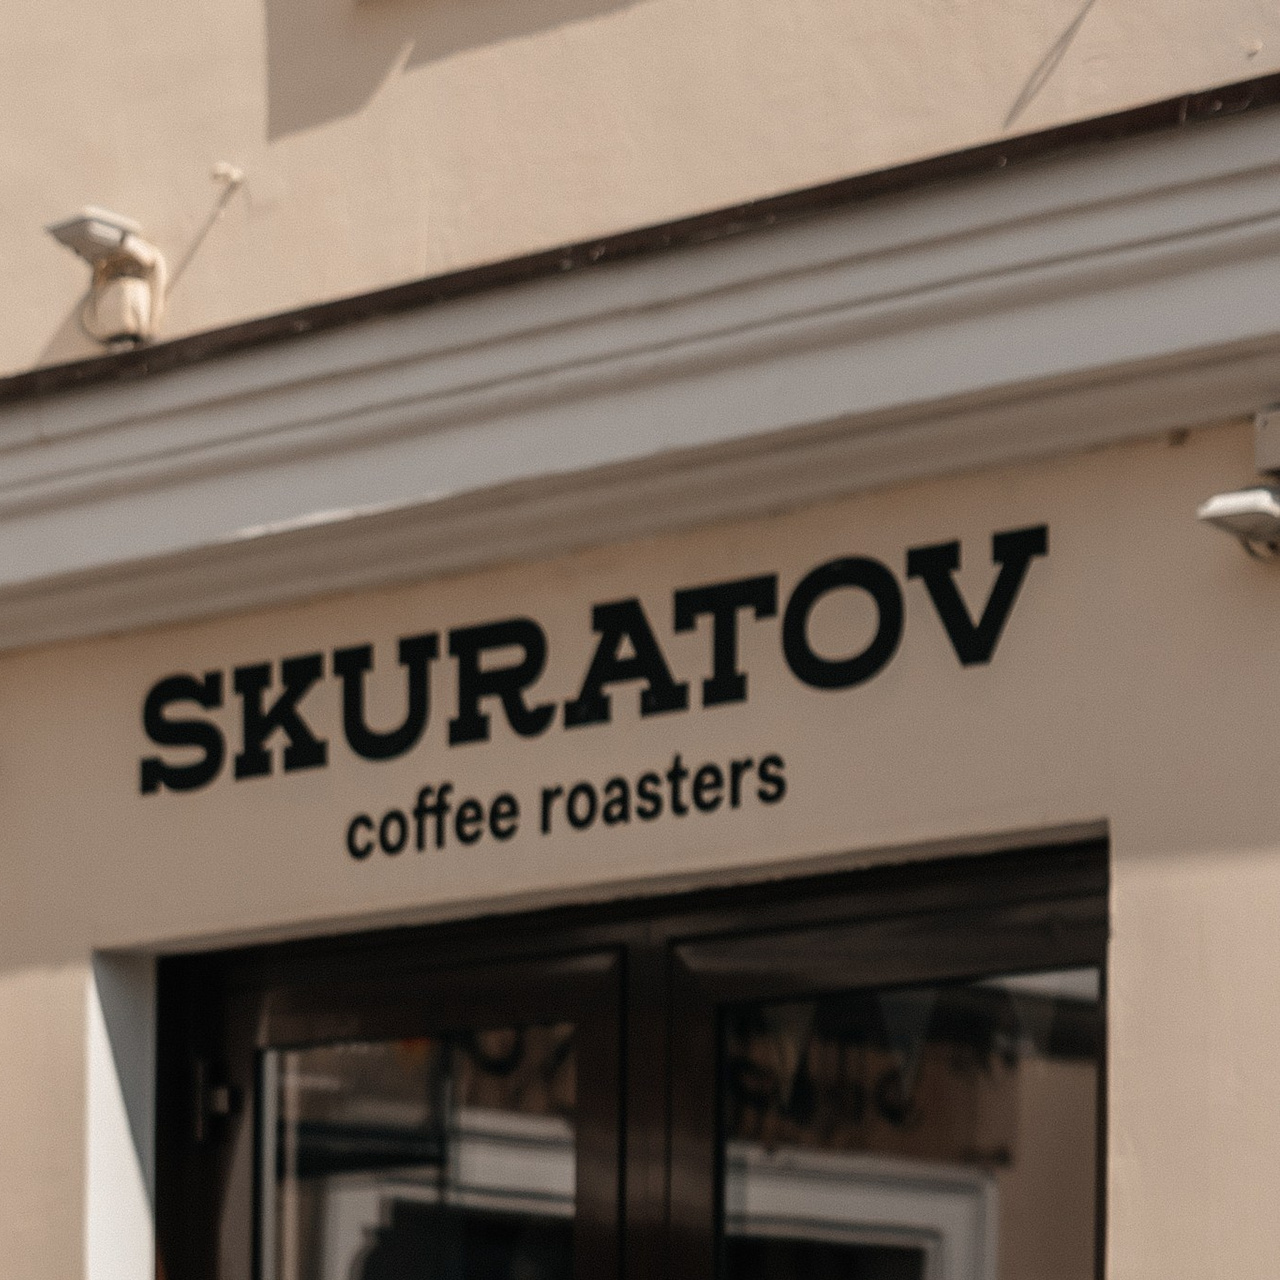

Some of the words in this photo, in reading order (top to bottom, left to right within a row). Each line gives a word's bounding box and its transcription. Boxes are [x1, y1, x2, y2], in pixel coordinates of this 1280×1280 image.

[139, 523, 1049, 796] SKURATOV
[346, 782, 520, 861] coffee
[540, 752, 788, 835] roasters
